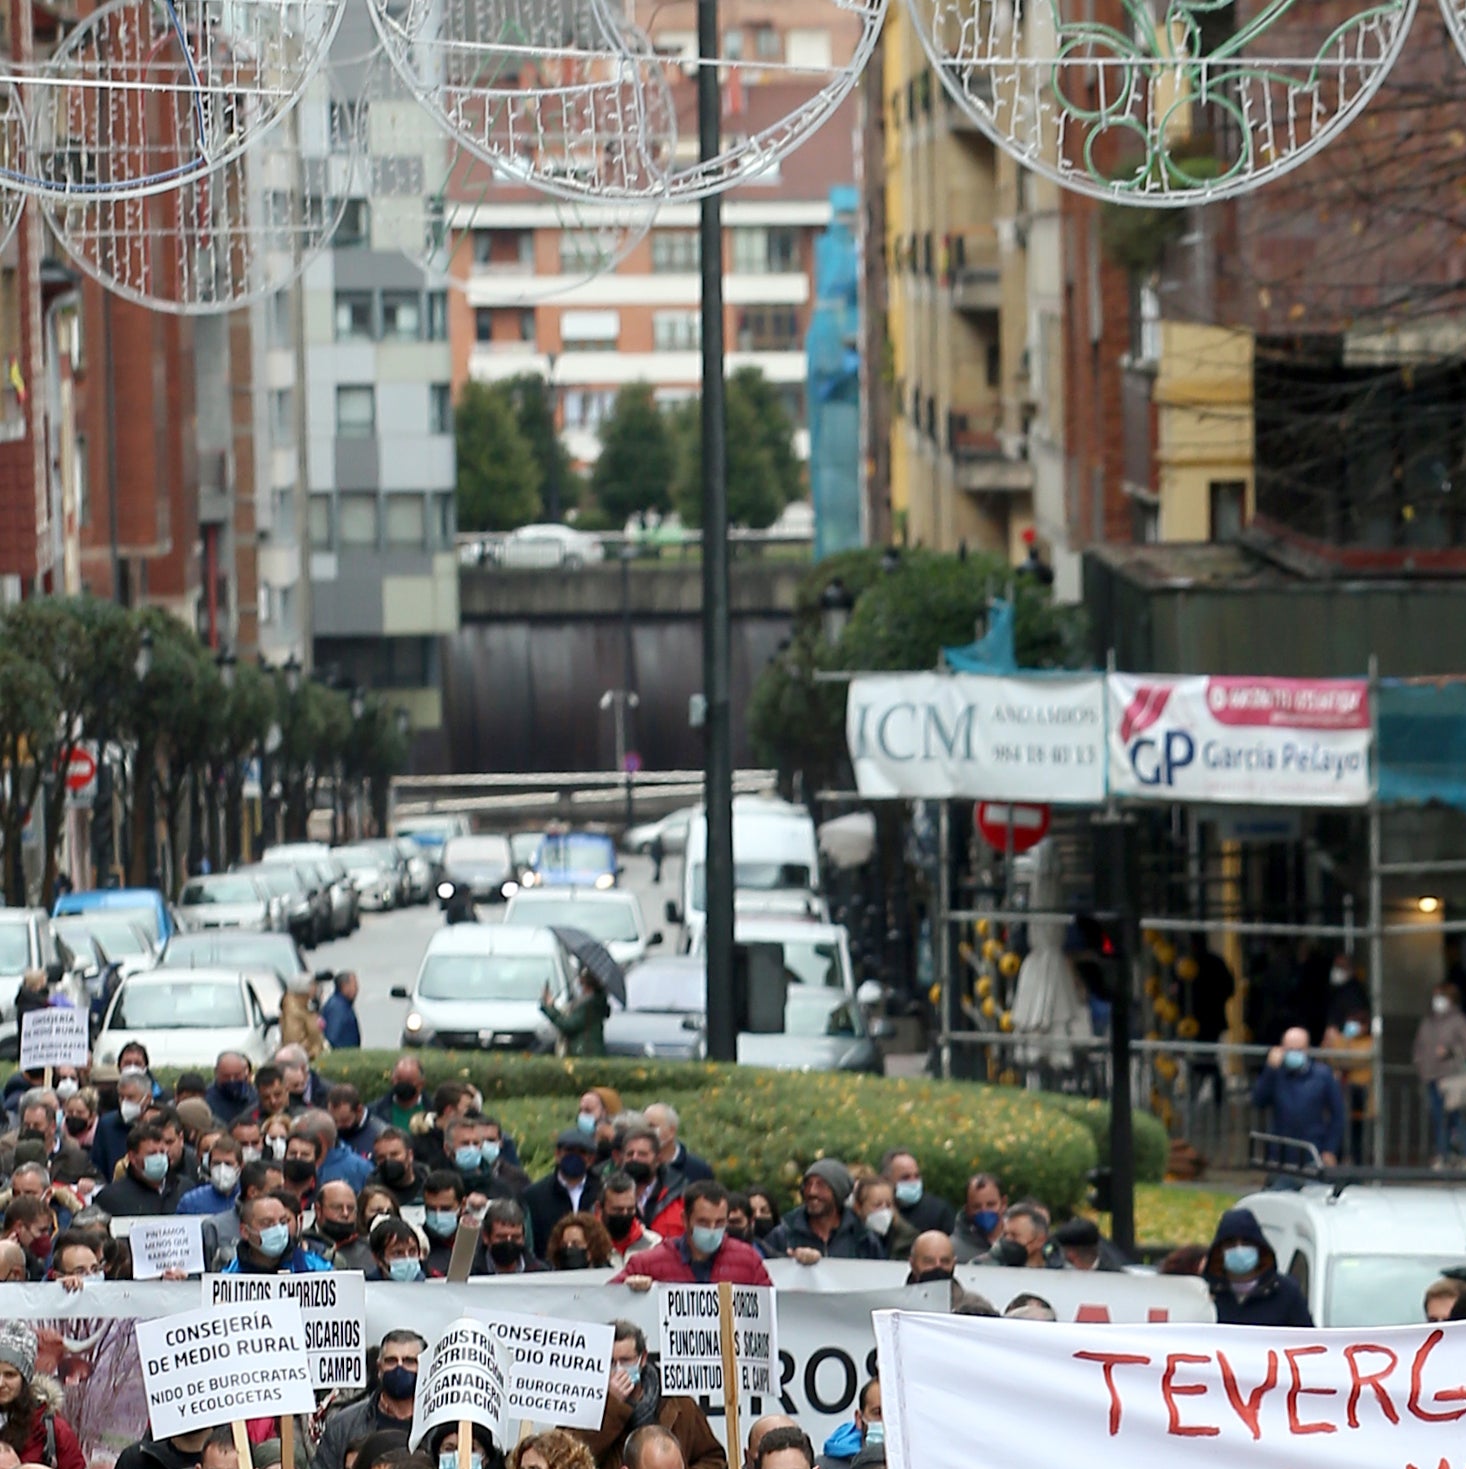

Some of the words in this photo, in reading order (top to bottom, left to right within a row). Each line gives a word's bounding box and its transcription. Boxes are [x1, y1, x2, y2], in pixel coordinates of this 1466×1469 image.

[1129, 731, 1195, 787] GP
[668, 1290, 719, 1317] POLITICOS
[165, 1310, 273, 1347] CONSEJERÍA
[305, 1320, 360, 1349] SICARIOS
[148, 1356, 170, 1376] DE
[175, 1343, 230, 1369] MEDIO
[237, 1336, 300, 1355] RURAL
[433, 1329, 495, 1361] INDUSTRIA
[319, 1356, 361, 1383] CAMPO
[429, 1348, 504, 1389] DISTRIBUCIÓN
[549, 1353, 605, 1374] RURAL
[664, 1364, 722, 1390] ESCLAVITUD
[151, 1386, 183, 1406] NIDO
[187, 1380, 206, 1397] DE
[209, 1367, 307, 1391] BUROCRATAS
[177, 1405, 187, 1417] Y
[191, 1388, 282, 1414] ECOLOGETAS
[434, 1373, 501, 1408] GANADERO
[516, 1377, 603, 1400] BUROCRATAS
[423, 1390, 500, 1423] LIQUIDACIÓN
